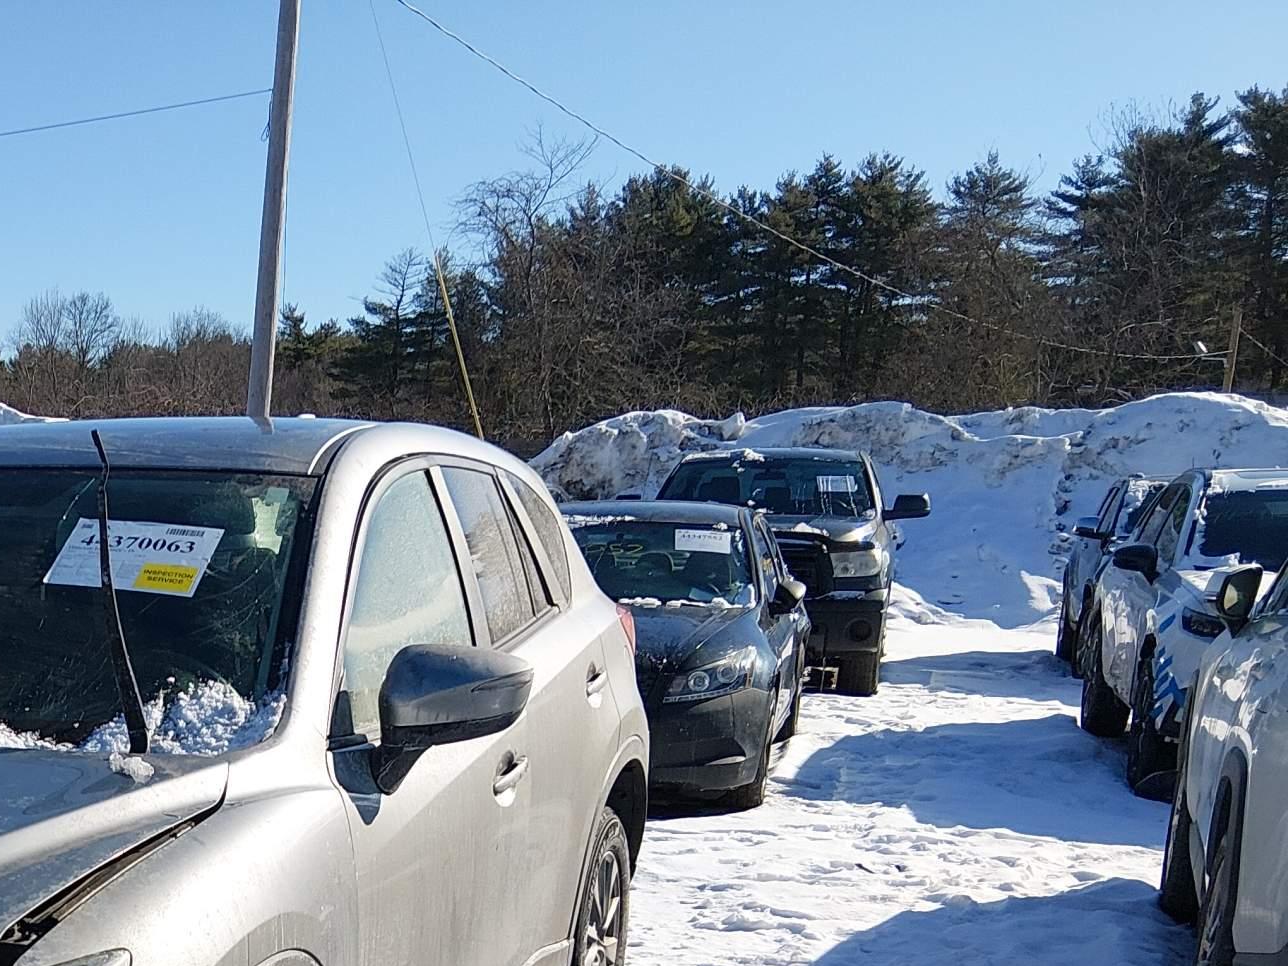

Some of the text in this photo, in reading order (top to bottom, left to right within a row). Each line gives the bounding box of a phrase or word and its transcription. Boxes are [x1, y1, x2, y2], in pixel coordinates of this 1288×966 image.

[80, 533, 197, 554] 4370063
[143, 568, 194, 580] INSPECTION
[146, 575, 185, 586] SERVICE
